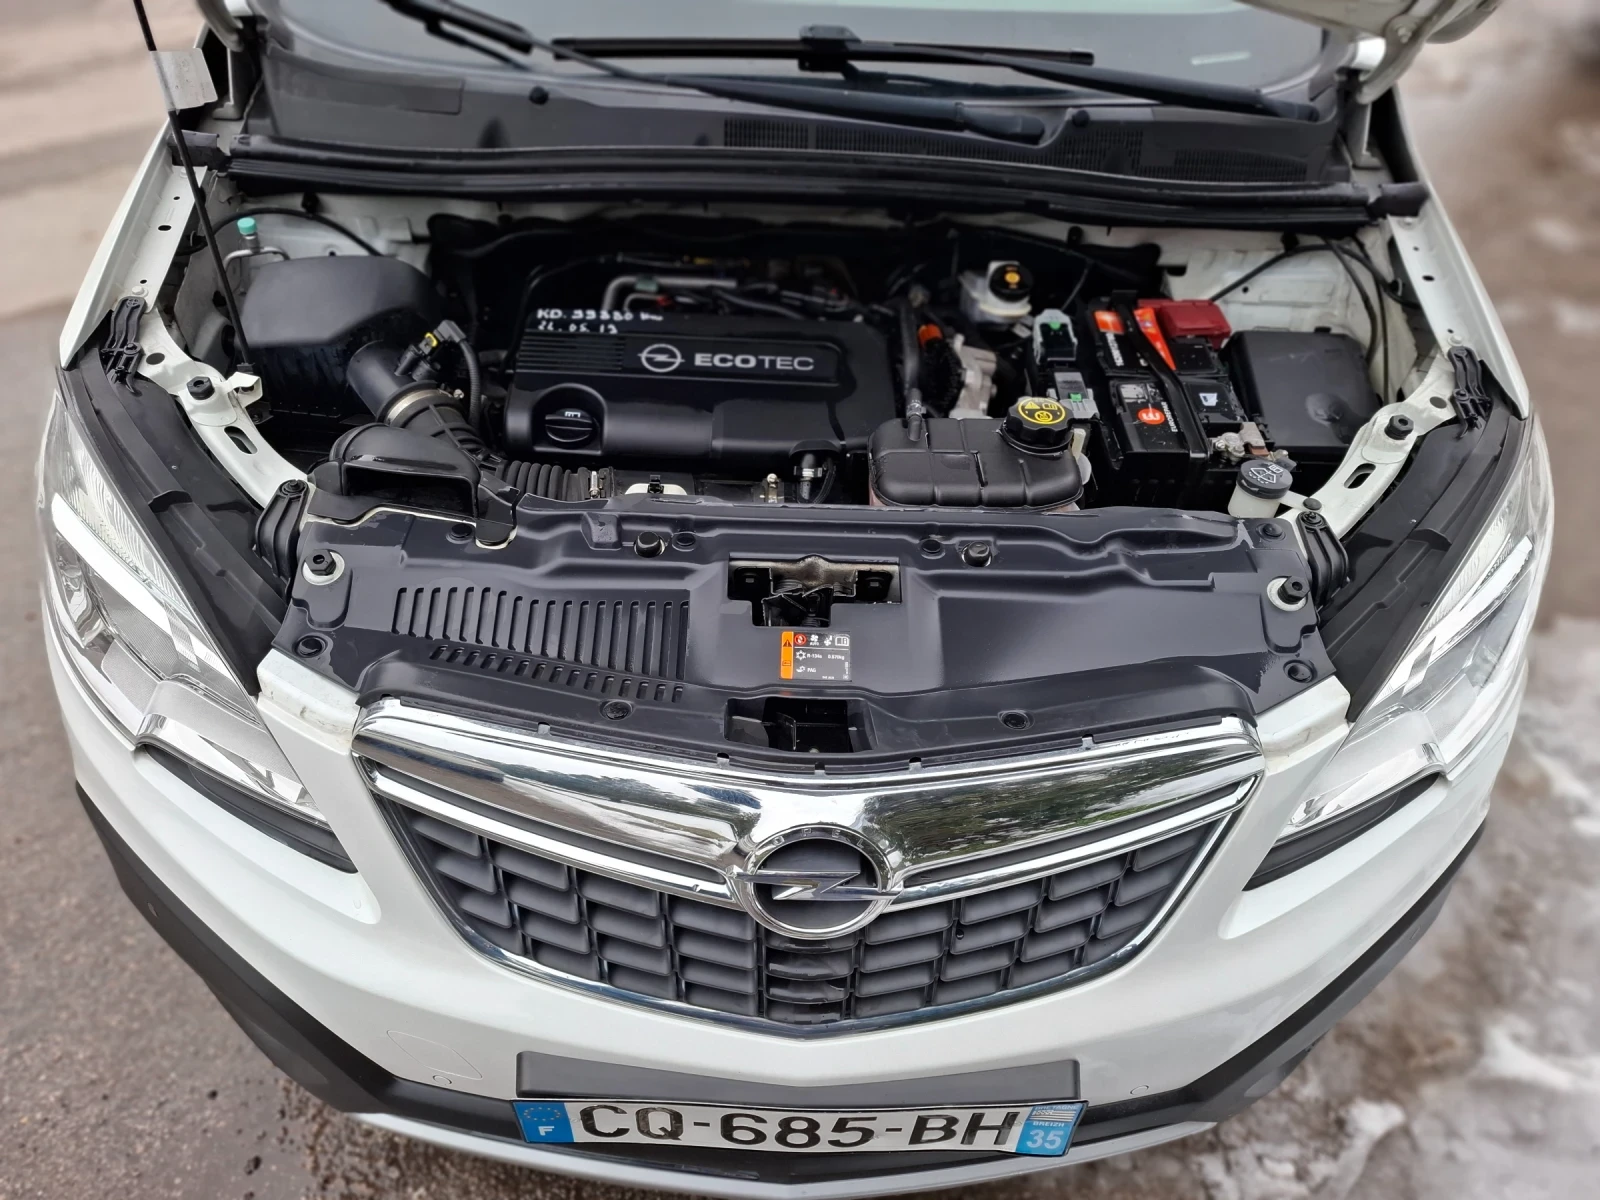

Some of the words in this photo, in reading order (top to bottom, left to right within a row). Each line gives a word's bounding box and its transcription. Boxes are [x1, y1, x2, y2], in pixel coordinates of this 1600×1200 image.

[694, 353, 815, 371] ECOTEC
[773, 827, 864, 849] OPEL
[538, 1125, 555, 1137] F
[579, 1104, 1020, 1149] CQ-685-BH
[1026, 1129, 1064, 1150] 35
